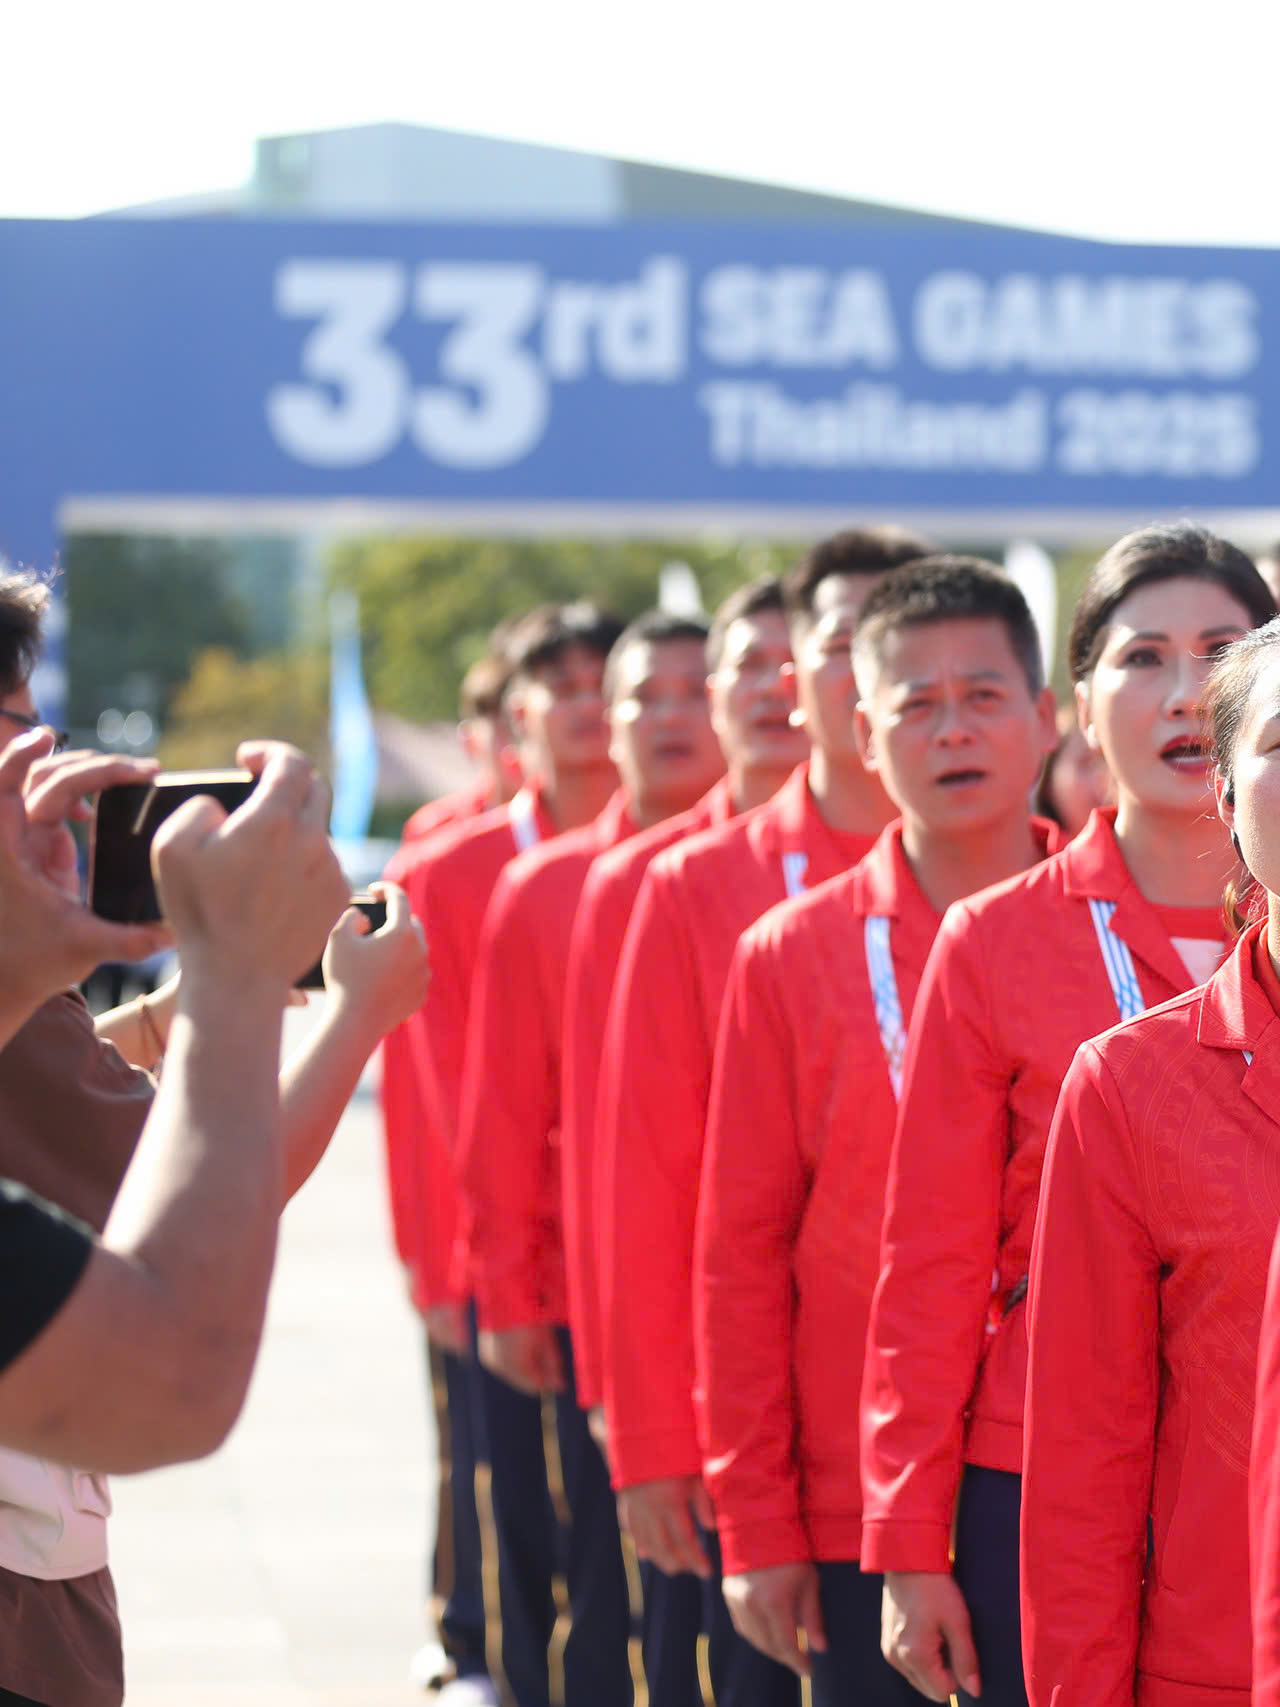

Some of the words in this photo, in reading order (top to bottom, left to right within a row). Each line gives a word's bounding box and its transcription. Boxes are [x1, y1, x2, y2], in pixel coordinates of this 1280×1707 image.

[269, 259, 688, 468] 33rd
[701, 266, 897, 369] SEA
[917, 271, 1258, 378] GAMES
[701, 380, 1046, 470] Thailand
[1058, 390, 1258, 477] 2025
